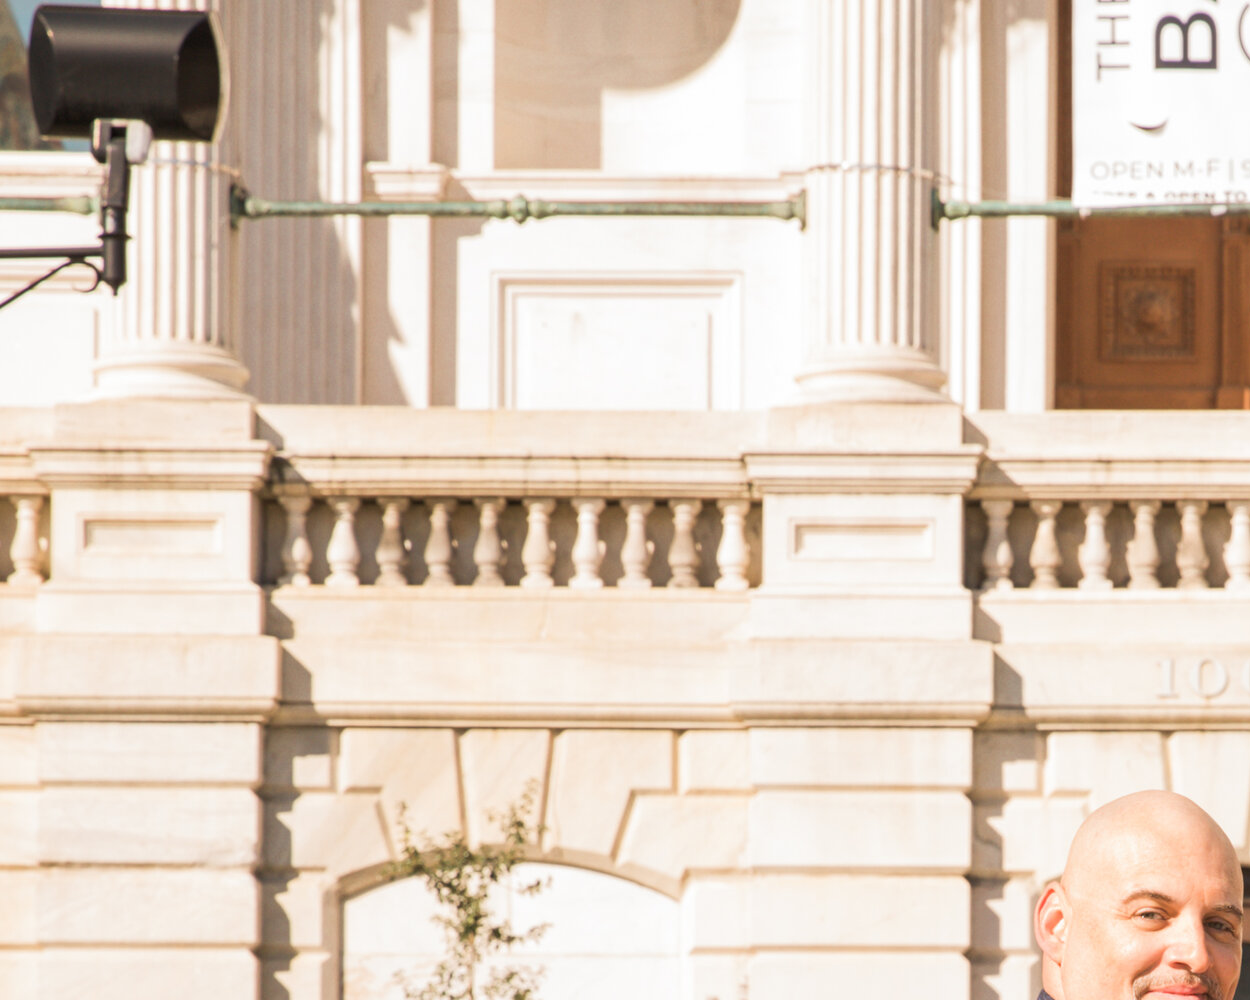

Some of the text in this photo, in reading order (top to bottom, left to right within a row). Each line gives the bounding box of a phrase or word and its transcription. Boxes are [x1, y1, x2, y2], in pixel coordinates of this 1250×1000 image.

[1097, 0, 1131, 82] TH
[1090, 159, 1164, 181] OPEN
[1223, 190, 1248, 204] TO
